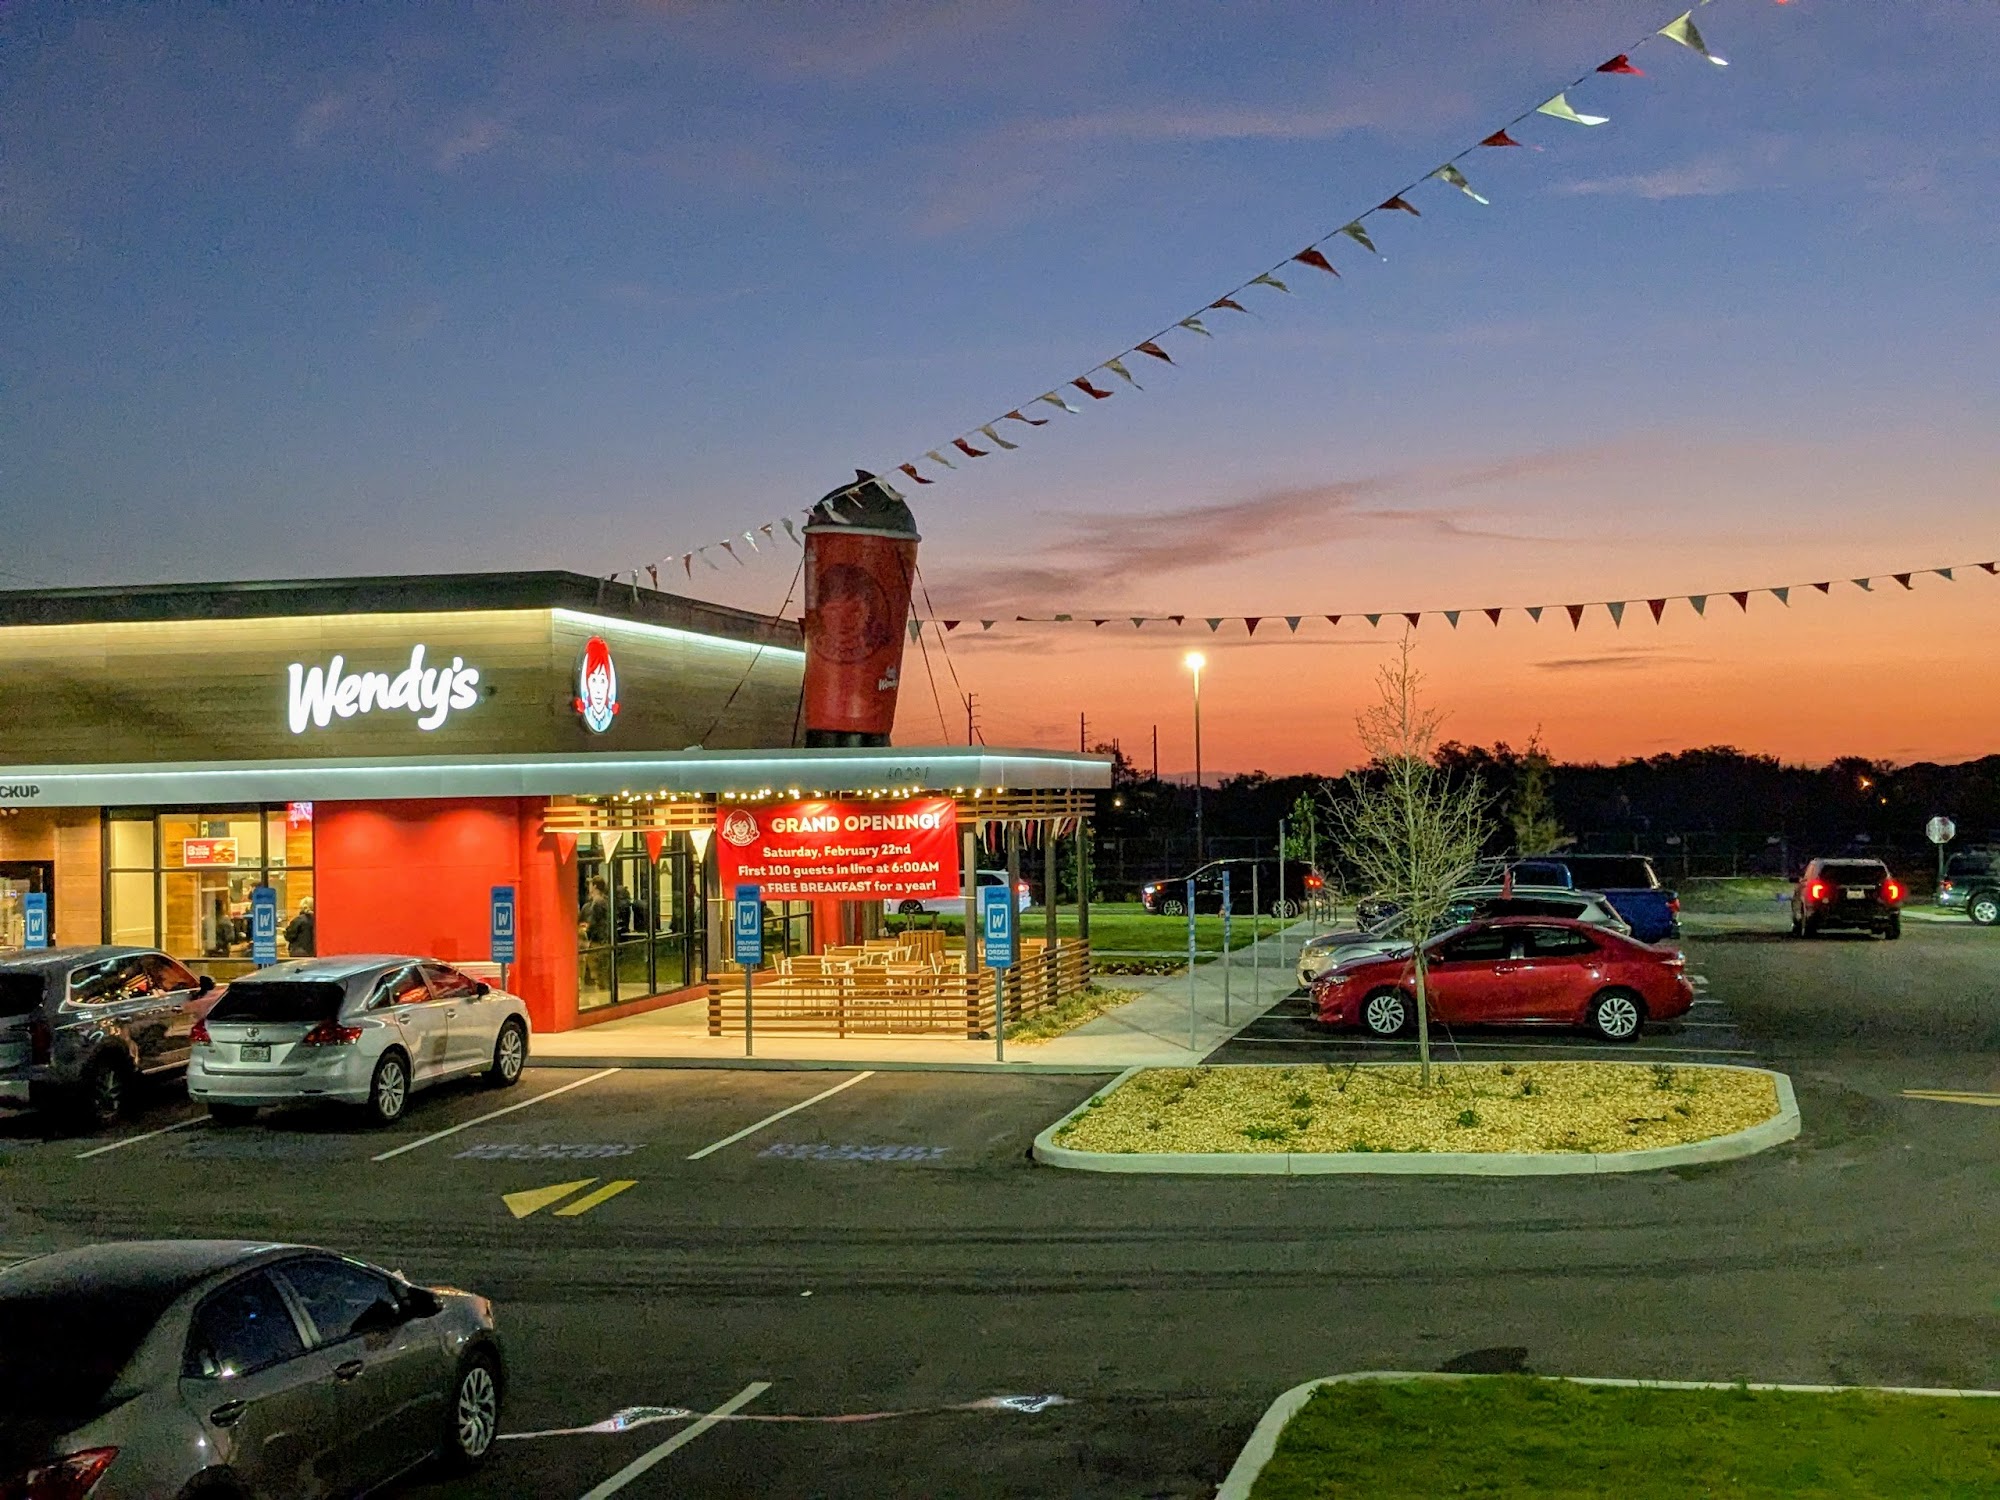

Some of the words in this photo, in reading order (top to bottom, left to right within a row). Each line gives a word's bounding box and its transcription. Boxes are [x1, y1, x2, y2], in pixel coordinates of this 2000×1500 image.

[288, 644, 480, 734] Wendy's
[0, 785, 40, 798] CKUP
[772, 816, 840, 833] GRAND
[844, 813, 940, 831] OPENING!
[763, 846, 822, 860] Saturday,
[825, 845, 878, 859] February
[881, 844, 911, 855] 22nd
[738, 865, 766, 876] First
[768, 865, 791, 876] 100
[793, 864, 834, 878] guests
[836, 864, 848, 875] in
[850, 863, 873, 875] line
[876, 863, 889, 874] at
[891, 861, 939, 873] 6:00AM
[768, 882, 798, 893] FREE
[800, 881, 872, 893] BREAKFAST
[873, 881, 892, 892] for
[894, 883, 902, 892] a
[904, 880, 936, 894] year!
[260, 912, 271, 928] W
[498, 909, 509, 926] W
[742, 910, 754, 926] W
[992, 913, 1004, 929] W
